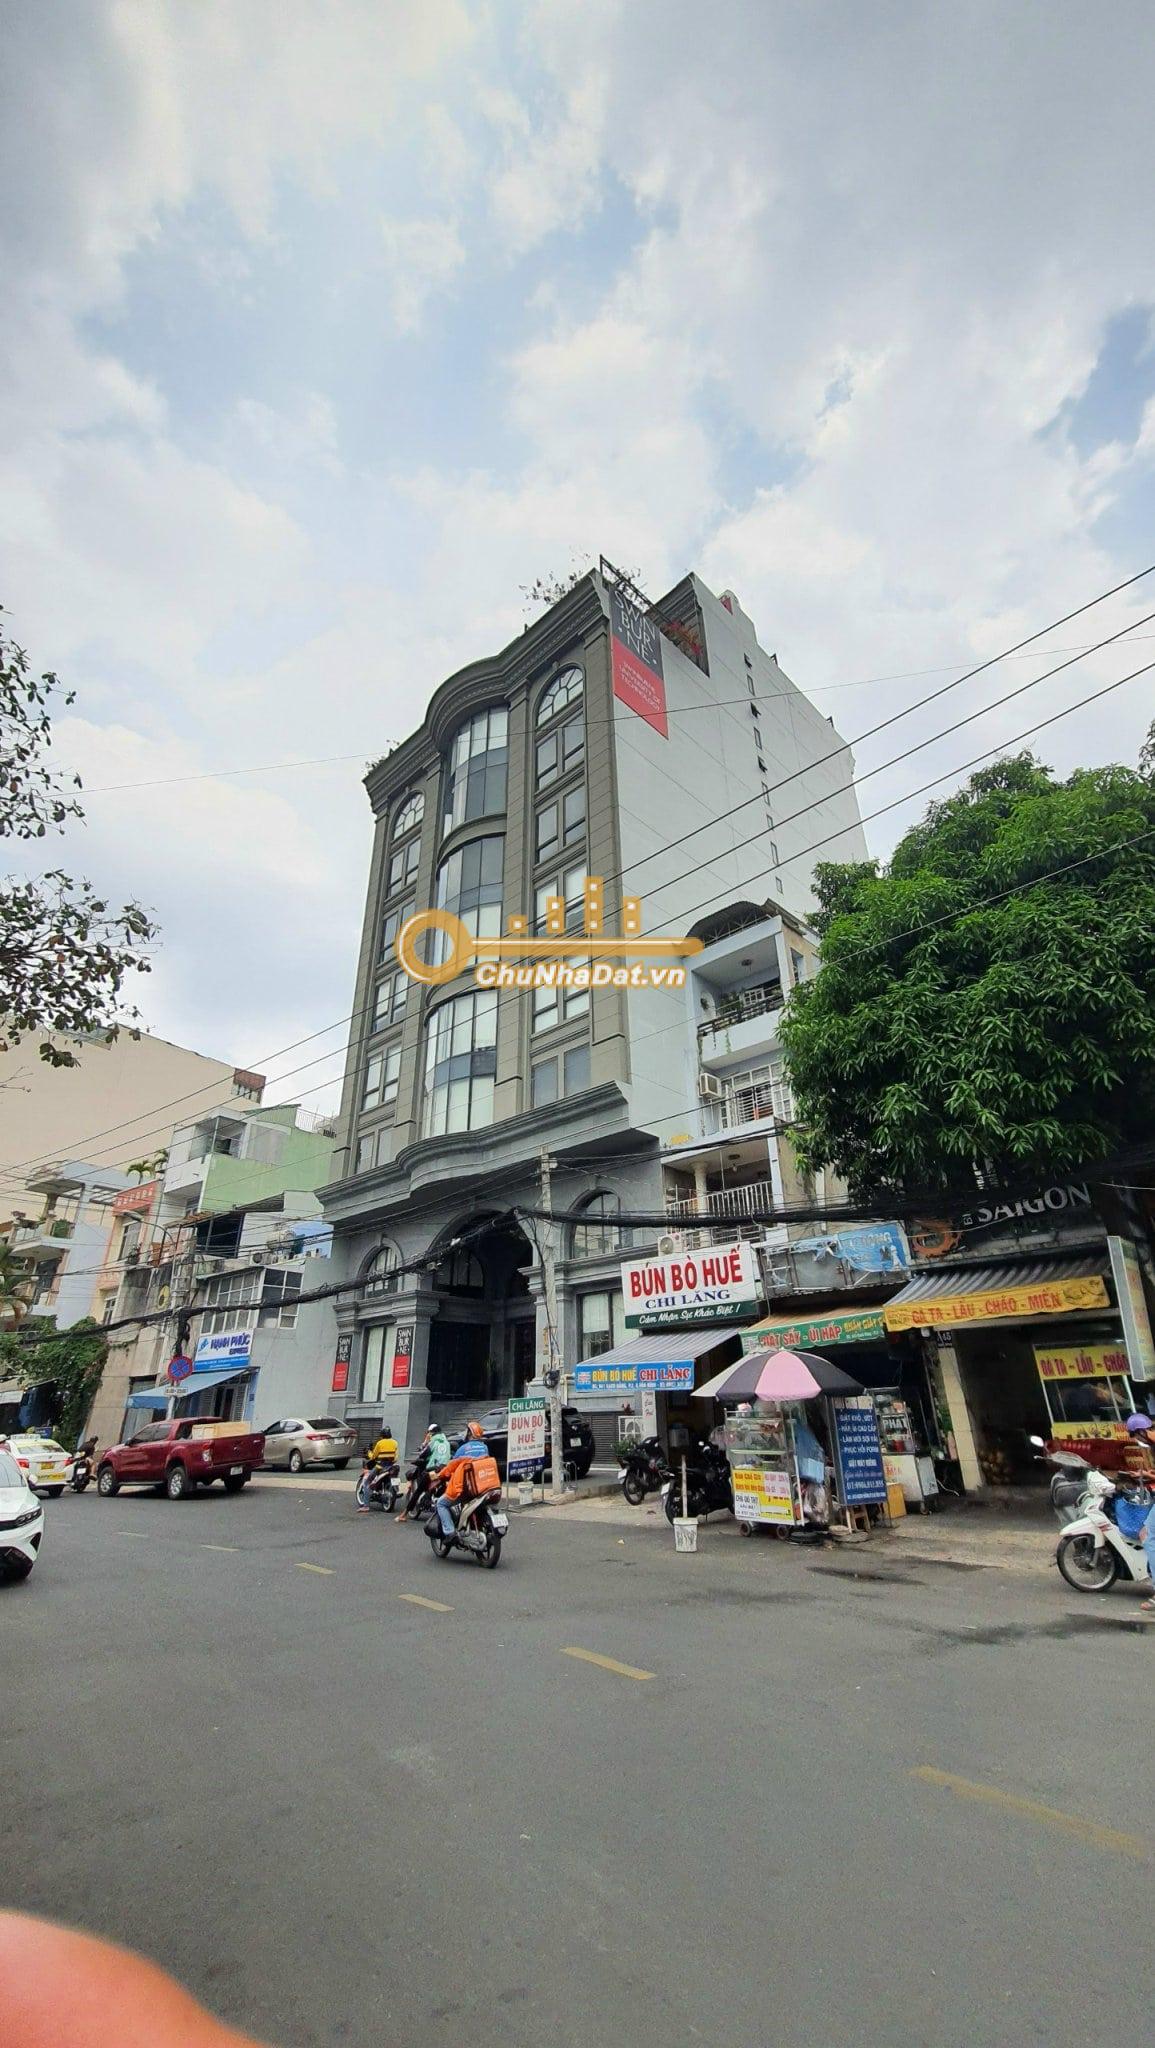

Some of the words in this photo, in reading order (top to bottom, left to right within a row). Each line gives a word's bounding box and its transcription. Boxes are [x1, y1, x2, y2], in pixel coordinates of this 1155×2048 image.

[978, 1182, 1091, 1222] SAIGON
[630, 1262, 666, 1298] BÚN
[670, 1255, 698, 1291] BÒ
[701, 1245, 743, 1287] HUẾ
[645, 1296, 676, 1309] CHI
[682, 1288, 731, 1305] LĂNG
[592, 1368, 608, 1382] BÚN
[639, 1368, 658, 1381] CHI
[660, 1364, 691, 1381] LĂNG
[512, 1402, 524, 1411] CHI
